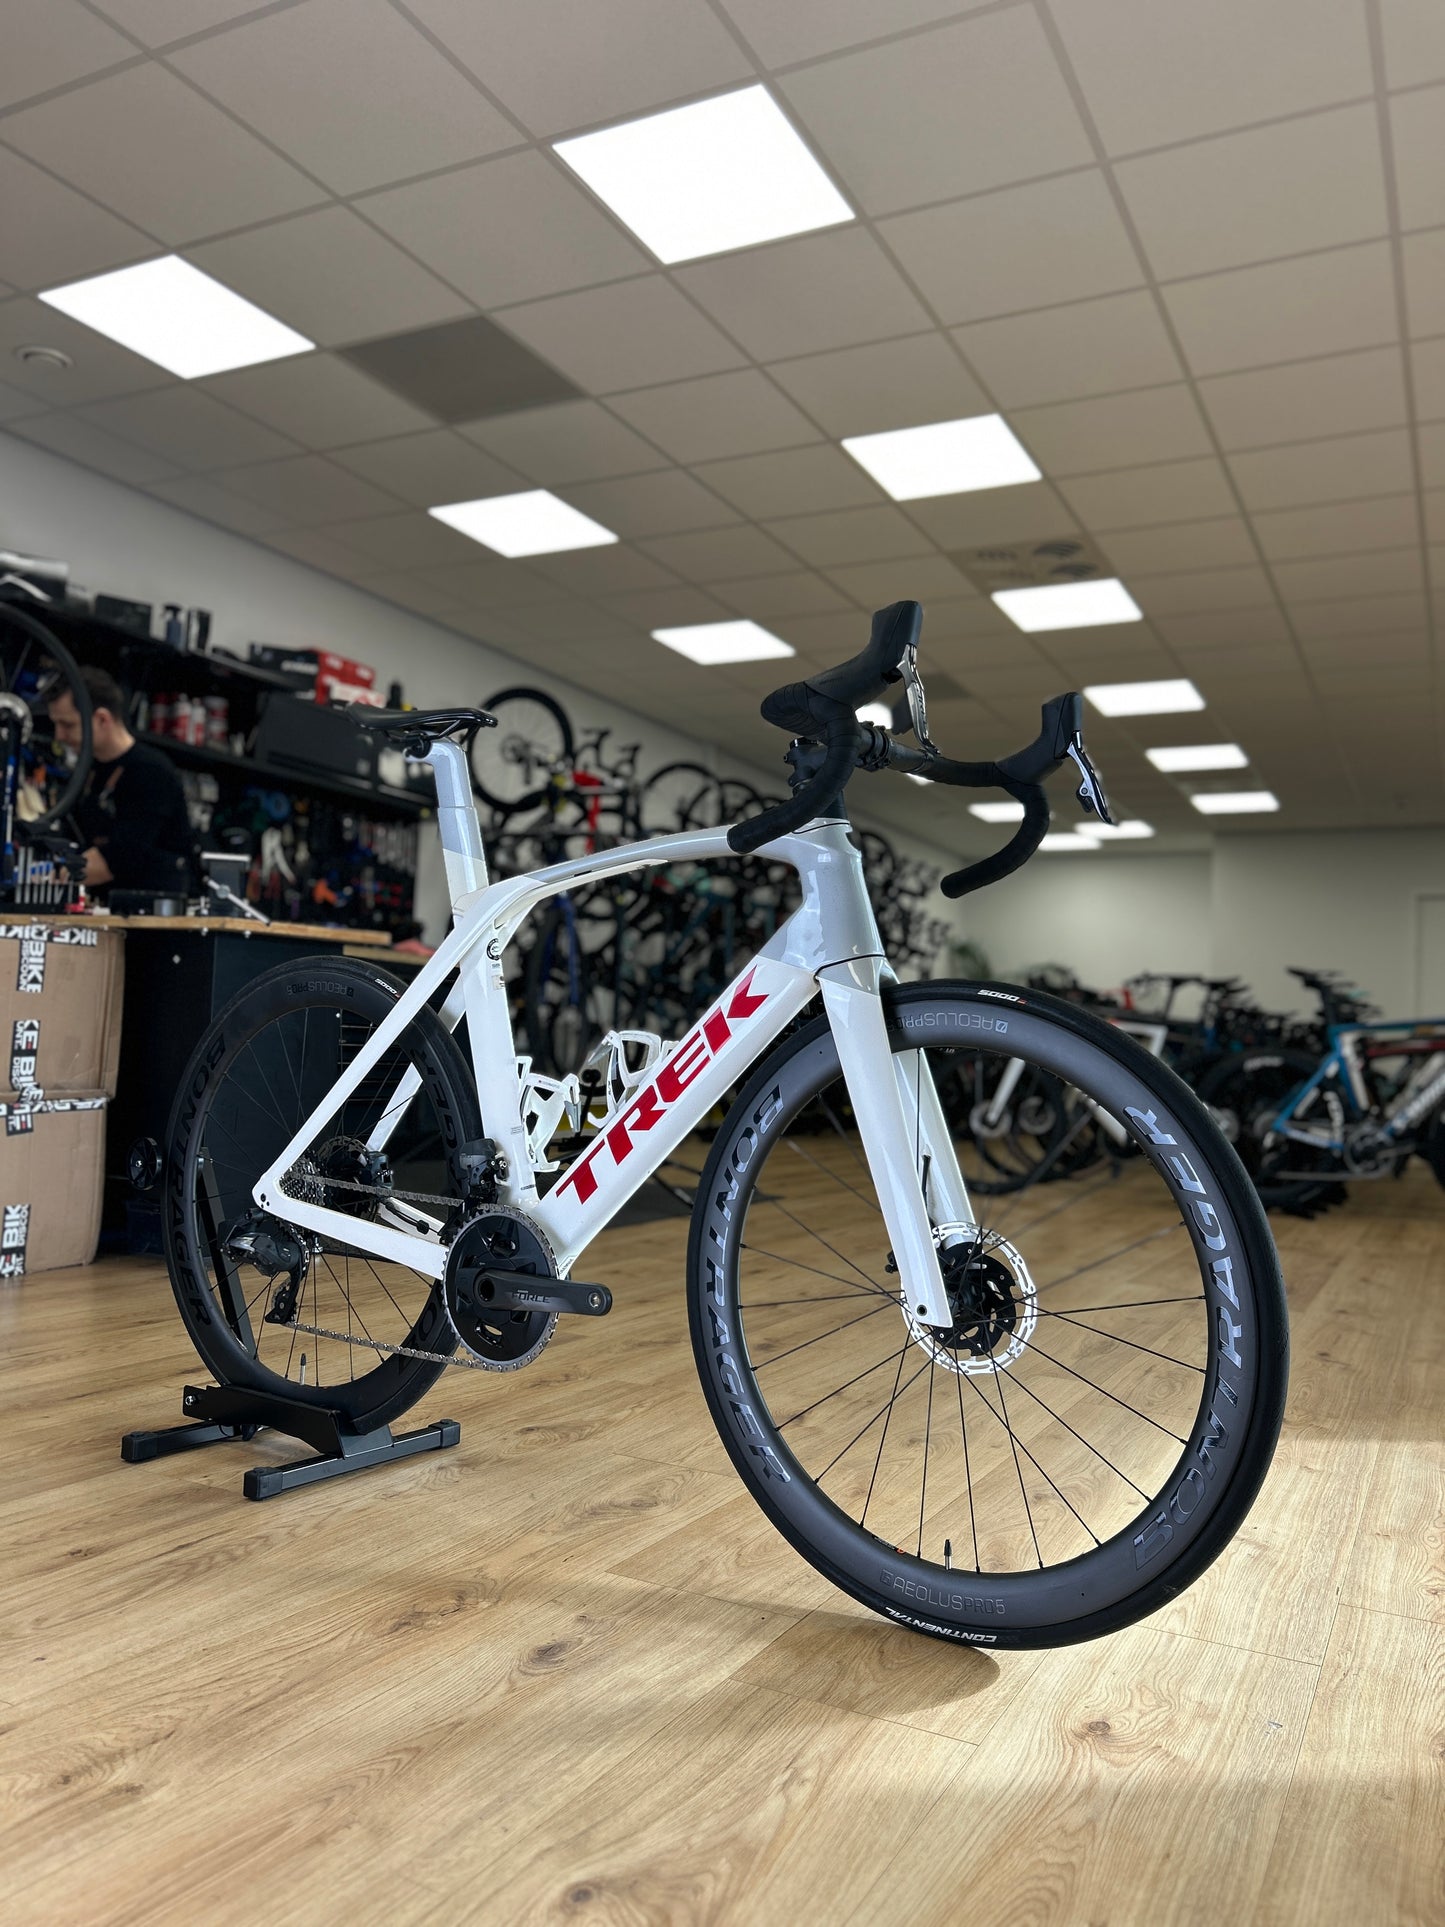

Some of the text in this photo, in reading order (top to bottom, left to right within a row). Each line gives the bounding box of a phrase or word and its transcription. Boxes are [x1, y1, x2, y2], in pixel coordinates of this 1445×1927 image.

[977, 989, 1020, 1002] 5000
[555, 964, 770, 1205] TREK
[169, 1032, 227, 1326] BONTRAGER
[512, 1292, 551, 1303] FORCE
[706, 1083, 791, 1483] BONTRAGER
[1123, 1105, 1244, 1571] BONTRAGER
[885, 1606, 998, 1643] CONTINENTAL
[893, 1576, 1006, 1615] AEOLUSPRO5
